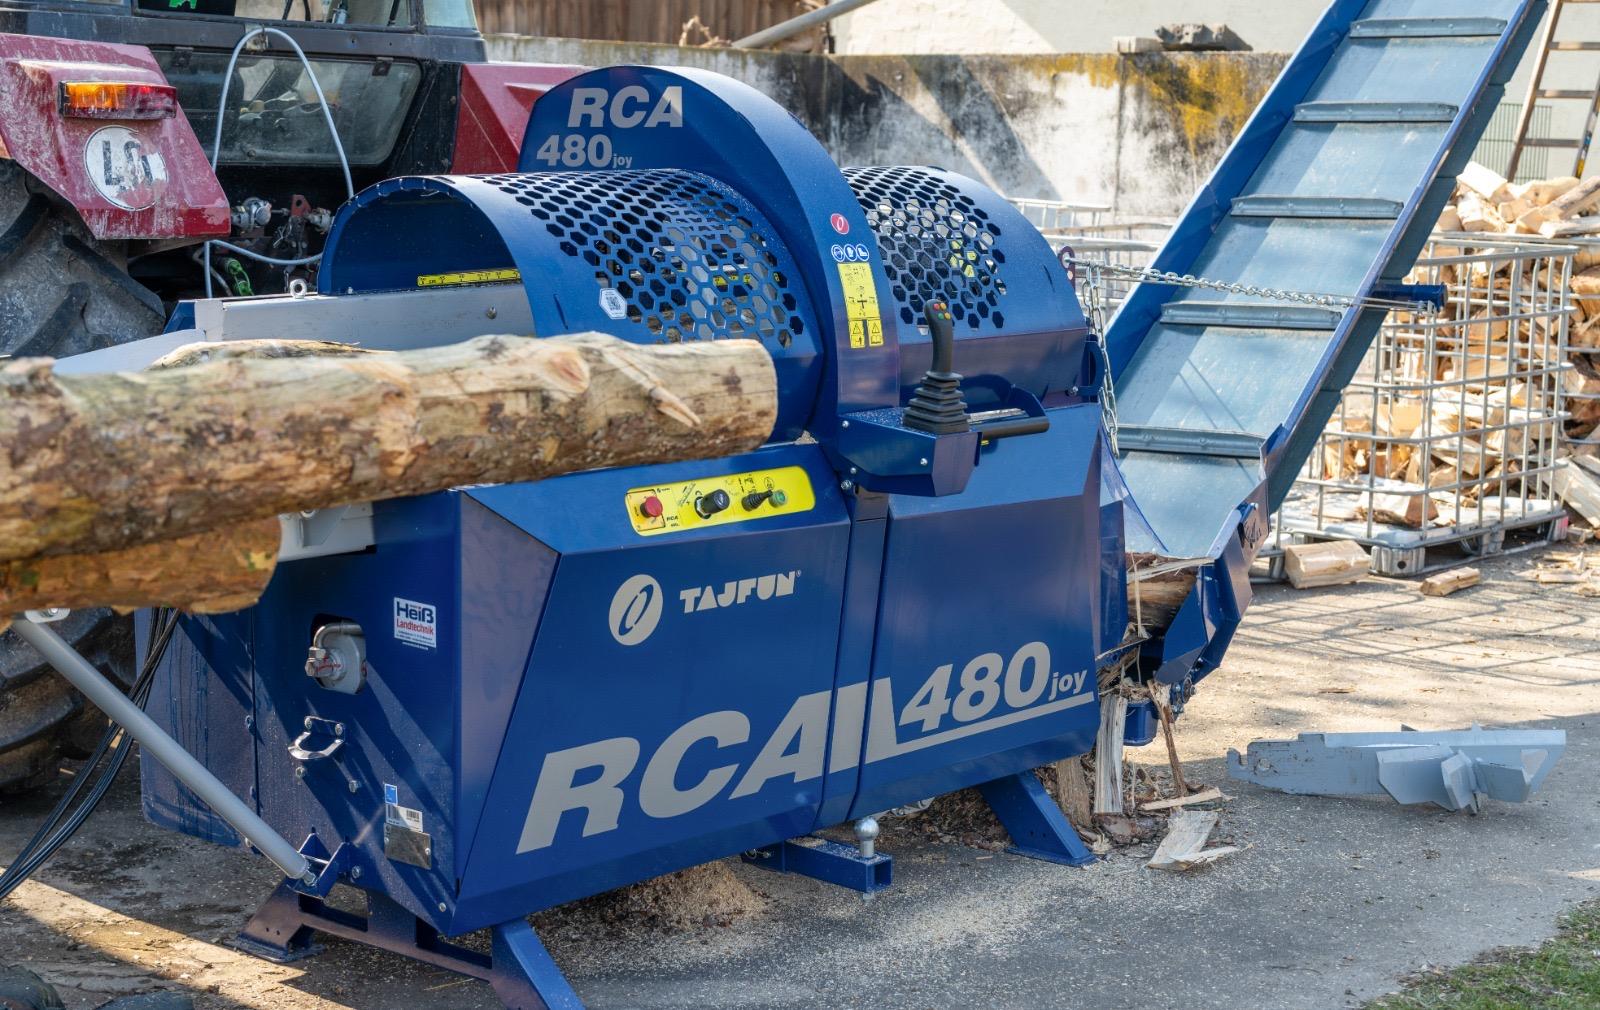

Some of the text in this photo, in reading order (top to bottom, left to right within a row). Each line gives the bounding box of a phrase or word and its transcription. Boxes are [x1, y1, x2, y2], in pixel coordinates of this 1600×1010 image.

[567, 85, 683, 129] RCA
[536, 133, 633, 169] 480 joy
[680, 570, 796, 614] TAJFUN
[396, 601, 434, 624] Heiß
[396, 617, 434, 636] Landtechnik
[898, 641, 1051, 734] 480
[1049, 667, 1088, 702] joy
